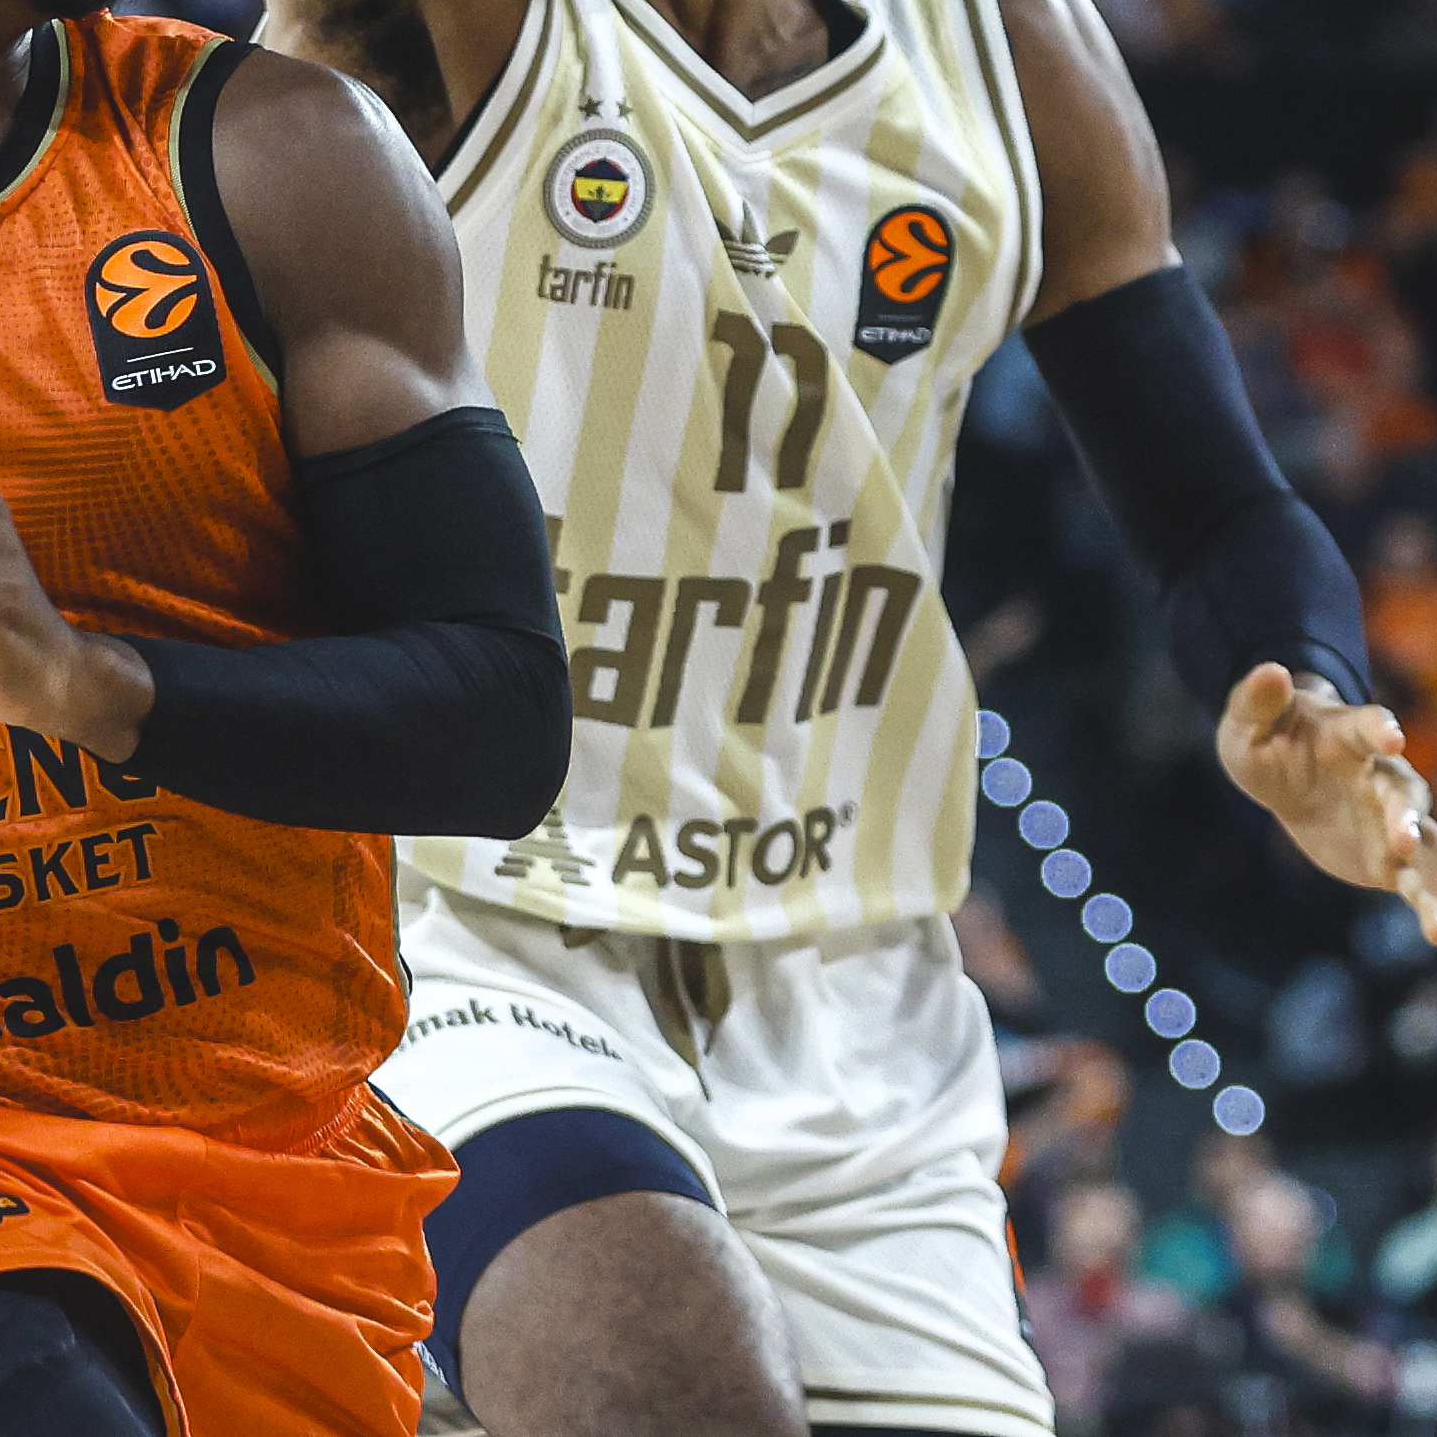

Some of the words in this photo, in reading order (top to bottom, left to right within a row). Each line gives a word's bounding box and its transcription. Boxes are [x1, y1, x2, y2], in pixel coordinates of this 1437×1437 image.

[538, 253, 636, 310] tarfin
[111, 359, 217, 391] ETIHAD
[547, 515, 922, 729] arfin
[399, 997, 500, 1051] mak
